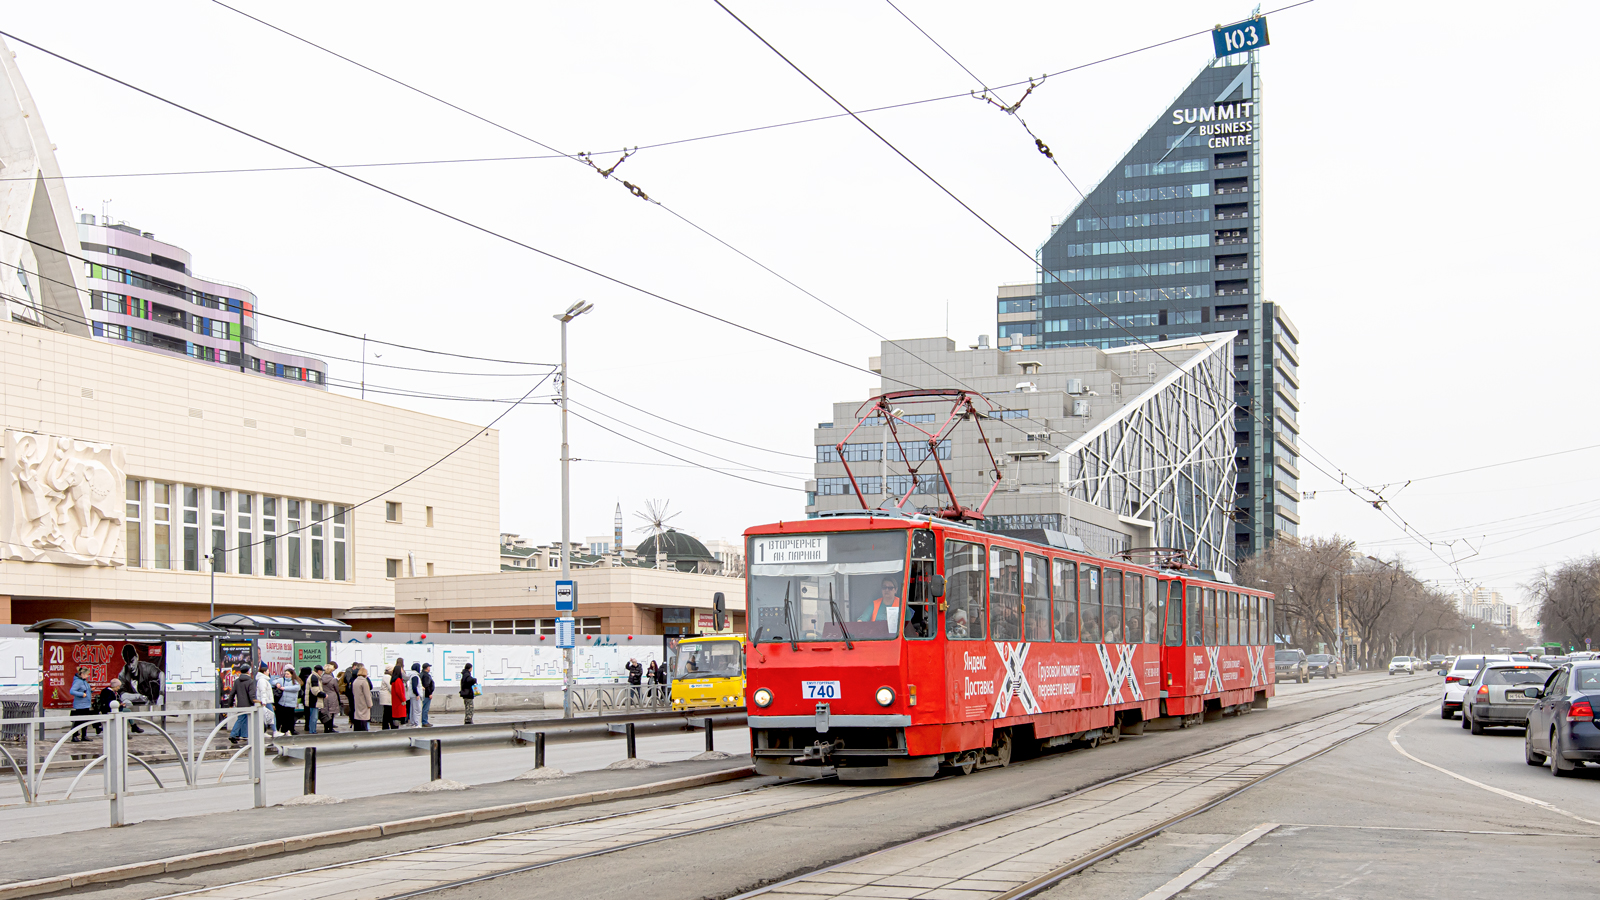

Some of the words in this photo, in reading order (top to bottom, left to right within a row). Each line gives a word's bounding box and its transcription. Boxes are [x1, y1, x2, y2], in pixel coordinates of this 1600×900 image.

[1172, 102, 1254, 125] SUMMIT
[1199, 120, 1253, 136] BUSINESS
[1208, 134, 1252, 149] CENTRE
[759, 542, 765, 562] 1
[768, 538, 822, 550] ВТОРЧЕРМЕТ
[49, 645, 65, 664] 20
[72, 643, 114, 664] СЕКТОР
[269, 642, 283, 650] АПРЕЛЯ
[963, 651, 987, 673] Яндекс
[1037, 661, 1060, 682] Грузовой
[1061, 664, 1081, 678] поможет
[808, 685, 835, 698] 740
[964, 676, 994, 700] Доставка
[1037, 684, 1063, 700] перевезти
[1063, 682, 1076, 698] вещи
